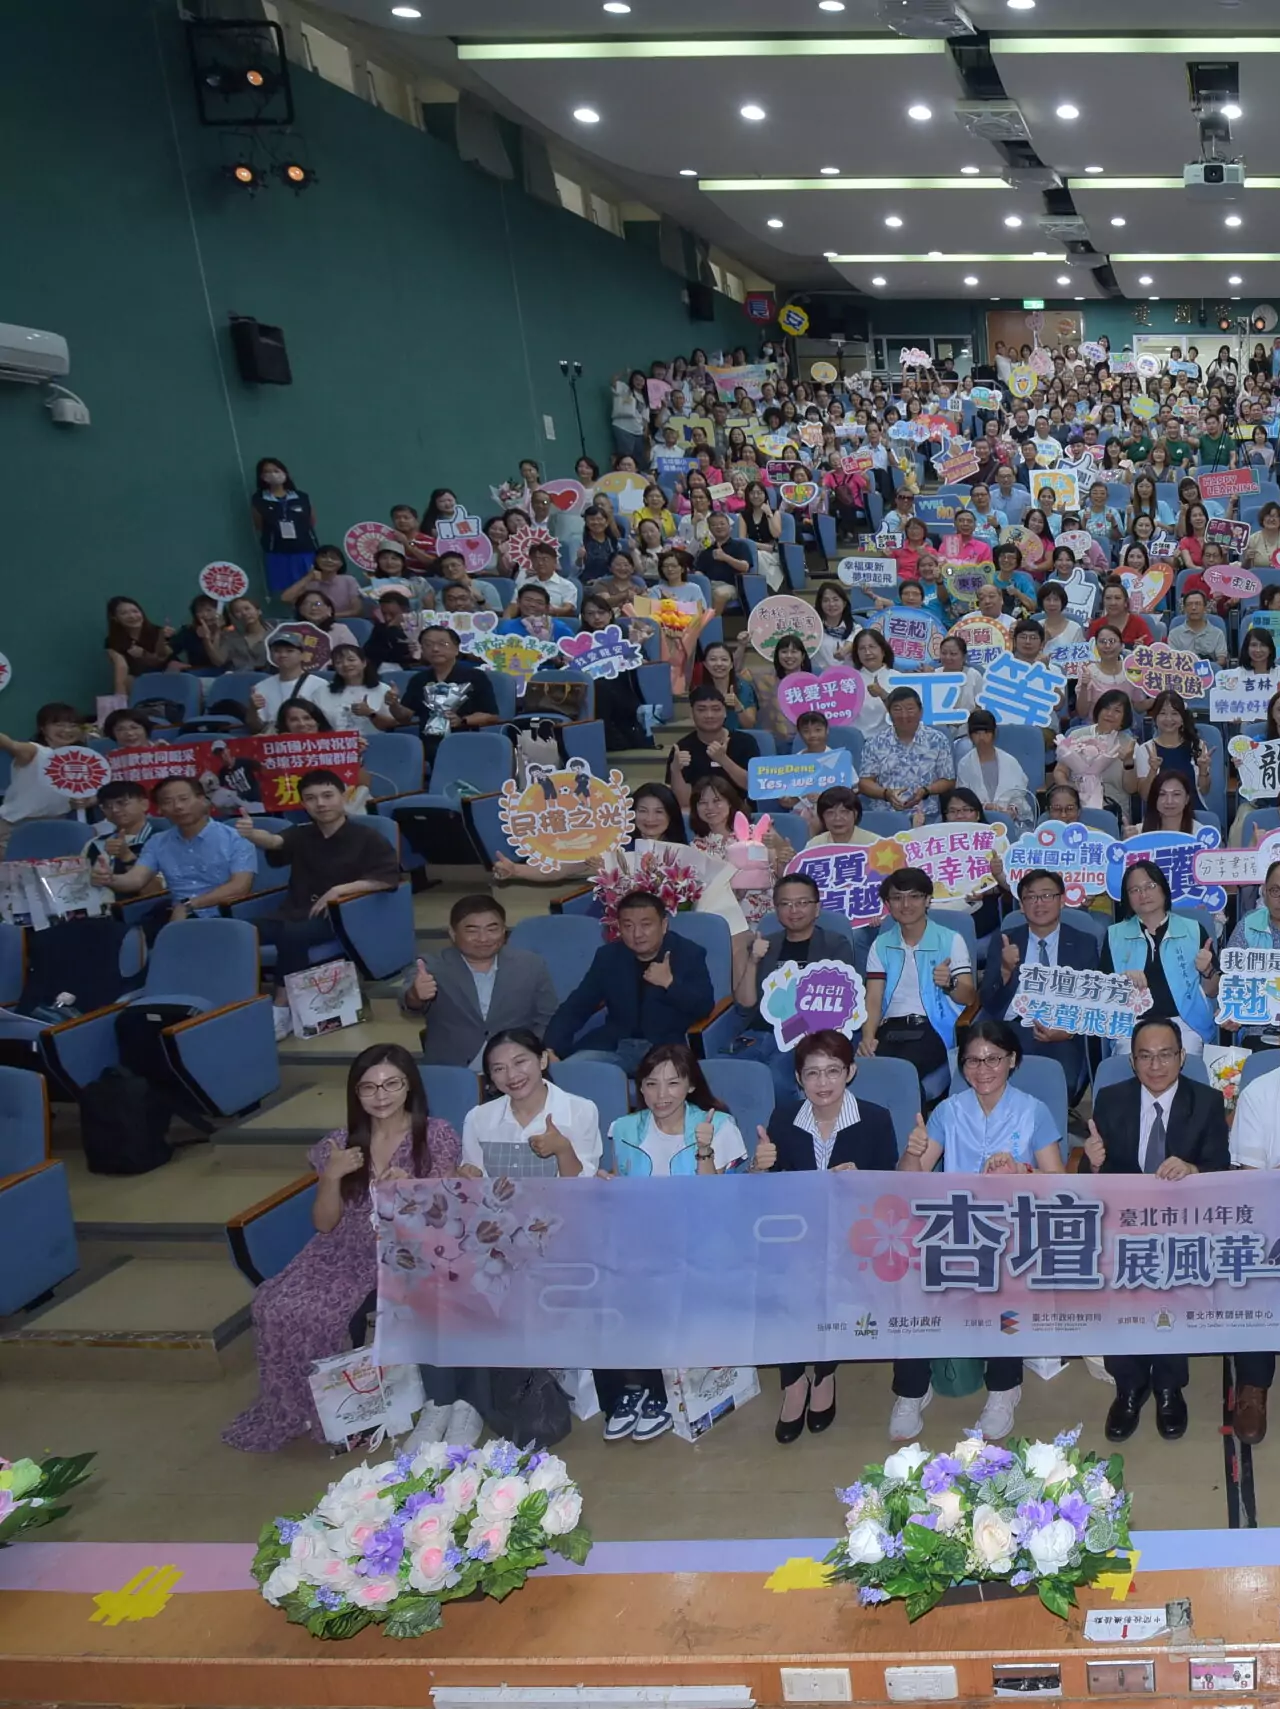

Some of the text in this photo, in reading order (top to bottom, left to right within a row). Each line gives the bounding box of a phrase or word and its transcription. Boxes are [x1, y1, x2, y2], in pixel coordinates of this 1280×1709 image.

[1203, 475, 1238, 486] HAPPY
[1206, 482, 1259, 495] LEARNING
[889, 617, 927, 638] 老松
[1050, 645, 1090, 660] 老松
[1135, 649, 1194, 673] 我老松
[785, 676, 857, 704] 我愛平等
[1242, 678, 1273, 692] 吉林
[817, 700, 838, 710] love
[758, 777, 787, 790] Yes,
[792, 776, 814, 787] we
[818, 776, 836, 788] go
[510, 803, 623, 837] 民權之光
[904, 831, 995, 862] 我在民權
[1010, 842, 1105, 866] 民權國中讚
[800, 852, 866, 889] 優質
[1022, 967, 1132, 1004] 杏壇芬芳
[800, 995, 844, 1012] CALL
[1026, 999, 1134, 1037] 笑聲飛揚
[914, 1194, 1102, 1289] 杏壇
[1115, 1235, 1263, 1288] 展風華
[888, 1316, 942, 1328] 臺北市政府
[1200, 1681, 1214, 1690] 10
